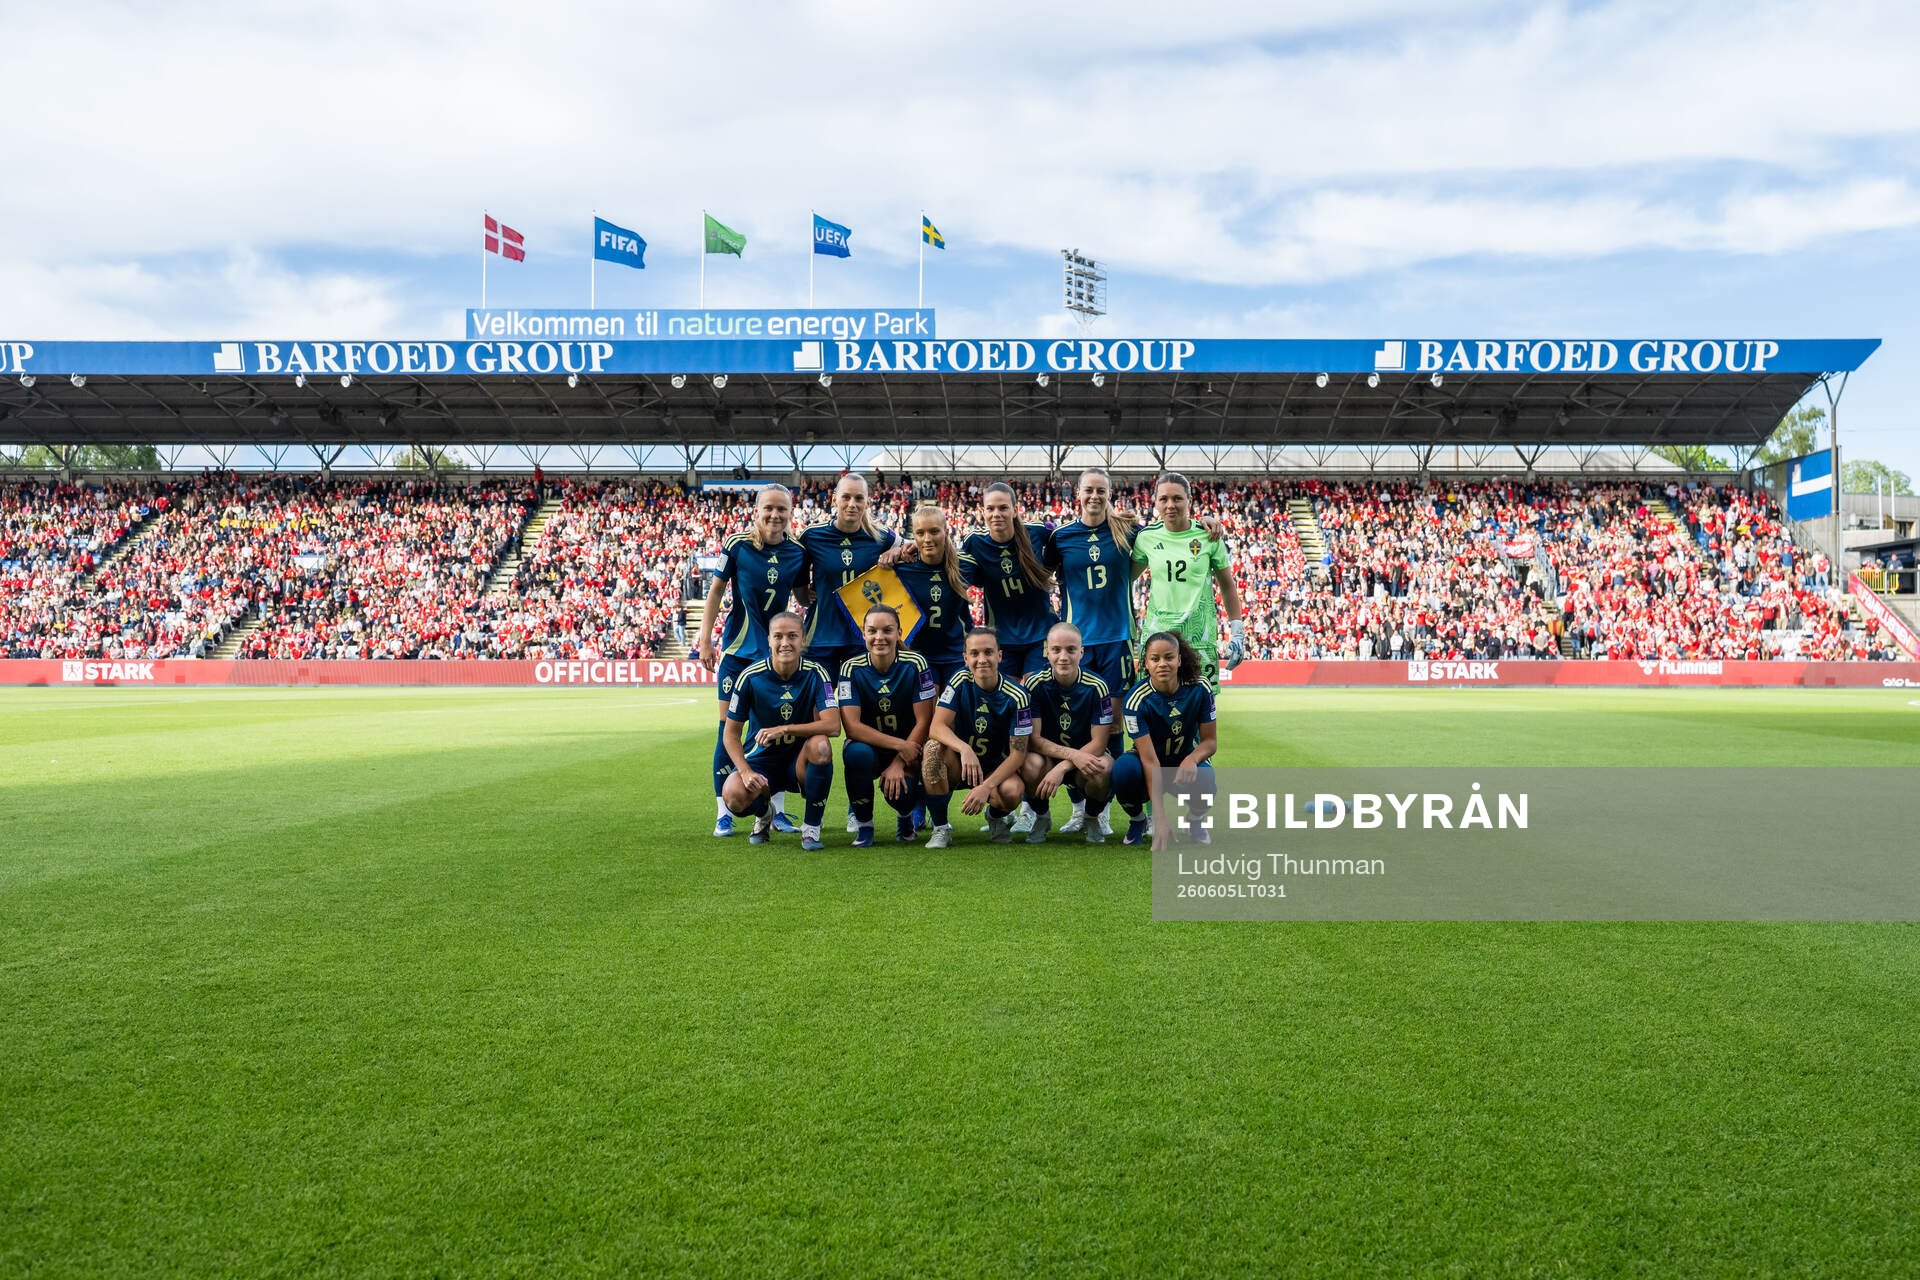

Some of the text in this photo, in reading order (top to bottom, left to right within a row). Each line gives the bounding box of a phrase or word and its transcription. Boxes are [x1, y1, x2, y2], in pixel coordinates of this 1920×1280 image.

[601, 230, 639, 255] FIFA
[815, 227, 847, 249] UEFA
[472, 312, 929, 340] Velkommen til nature energy Park
[255, 342, 614, 373] BARFOED GROUP
[835, 340, 1195, 372] BARFOED GROUP
[1417, 340, 1779, 372] BARFOED GROUP
[1086, 565, 1107, 590] 13
[1166, 560, 1187, 582] 12
[1001, 576, 1024, 598] 14
[763, 588, 776, 612] 7
[929, 605, 942, 628] 2
[84, 663, 155, 680] STARK
[535, 661, 718, 683] OFFICIEL PART
[1430, 662, 1499, 679] STARK
[1659, 660, 1723, 675] hummel
[876, 714, 898, 732] 19
[1165, 736, 1185, 757] 17
